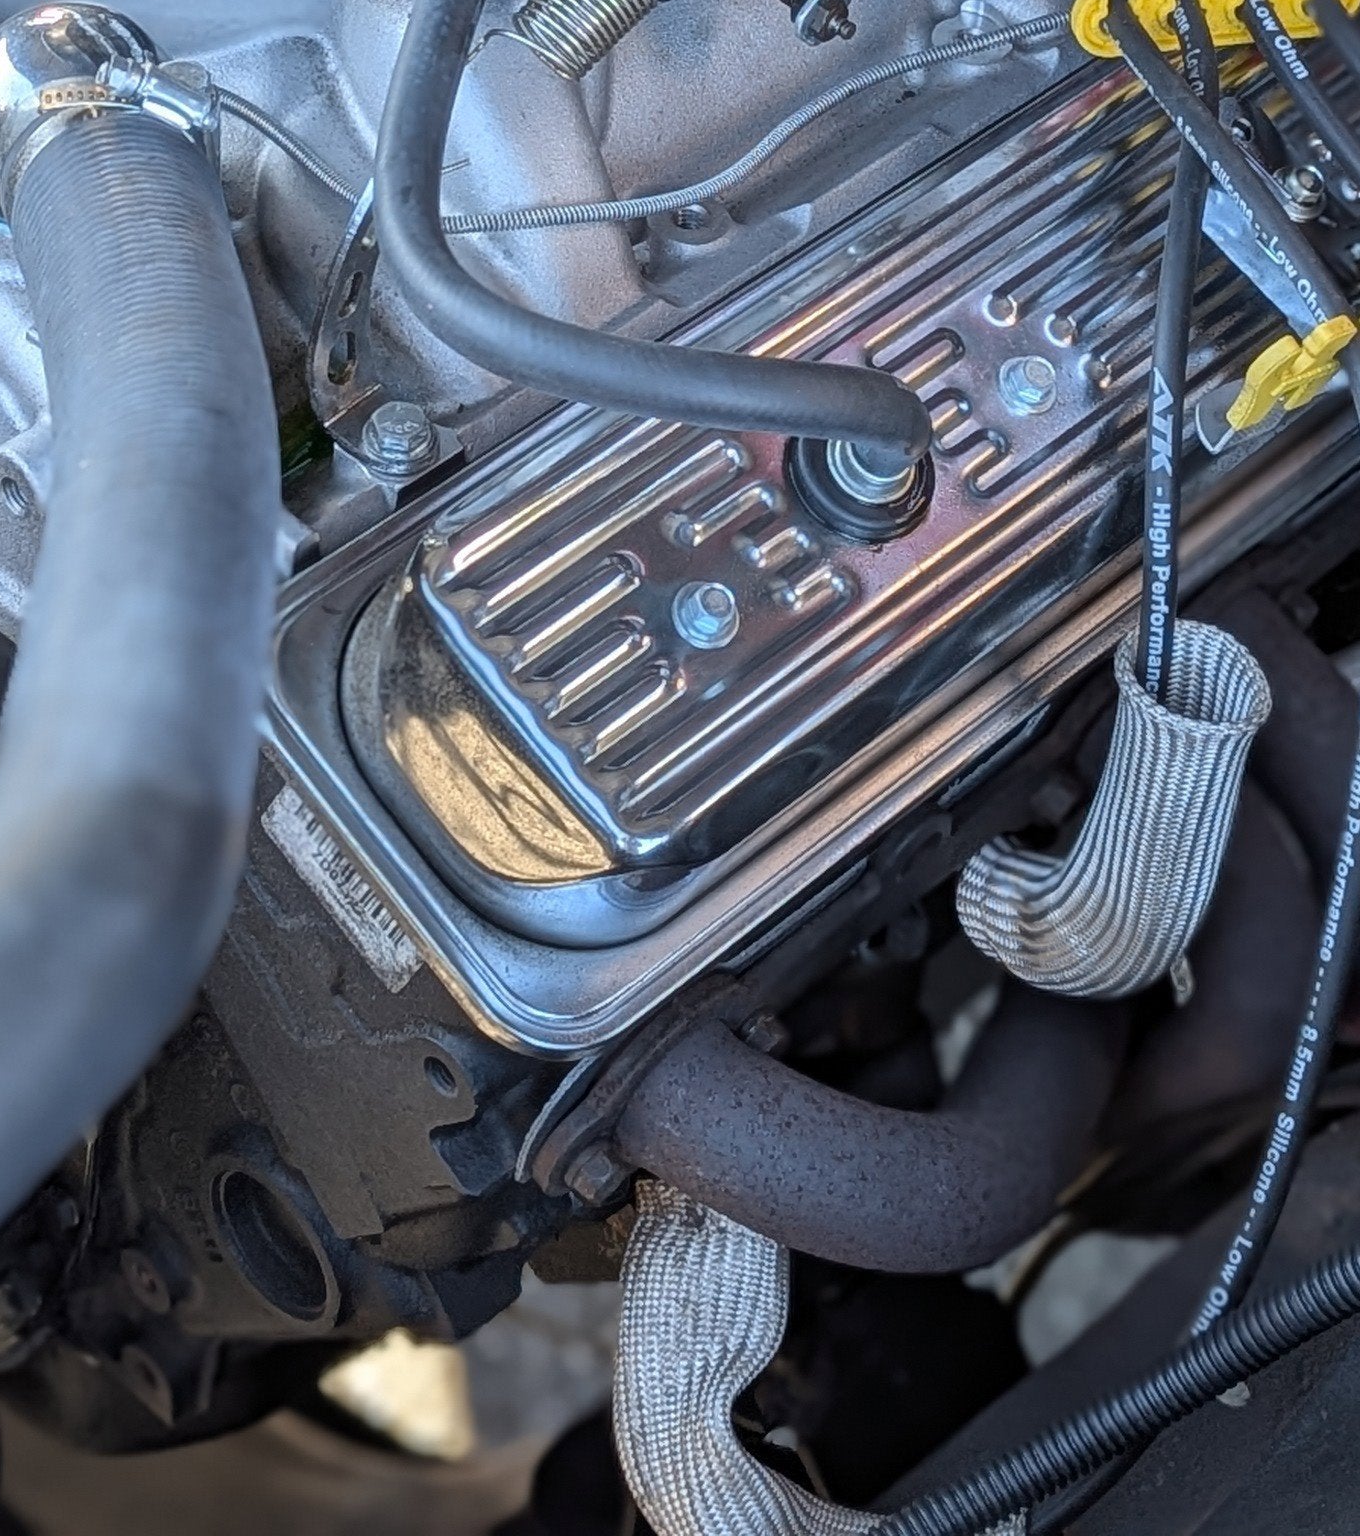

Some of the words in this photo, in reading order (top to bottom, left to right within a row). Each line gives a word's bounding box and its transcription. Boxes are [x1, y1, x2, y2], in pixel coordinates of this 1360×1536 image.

[1274, 34, 1309, 81] Ohm
[1270, 235, 1299, 283] Low
[1151, 366, 1175, 478] ATK
[1148, 502, 1172, 558] High
[1285, 1023, 1320, 1103] 8.5mm
[1252, 1111, 1296, 1204] Silicone
[1220, 1234, 1254, 1286] Low
